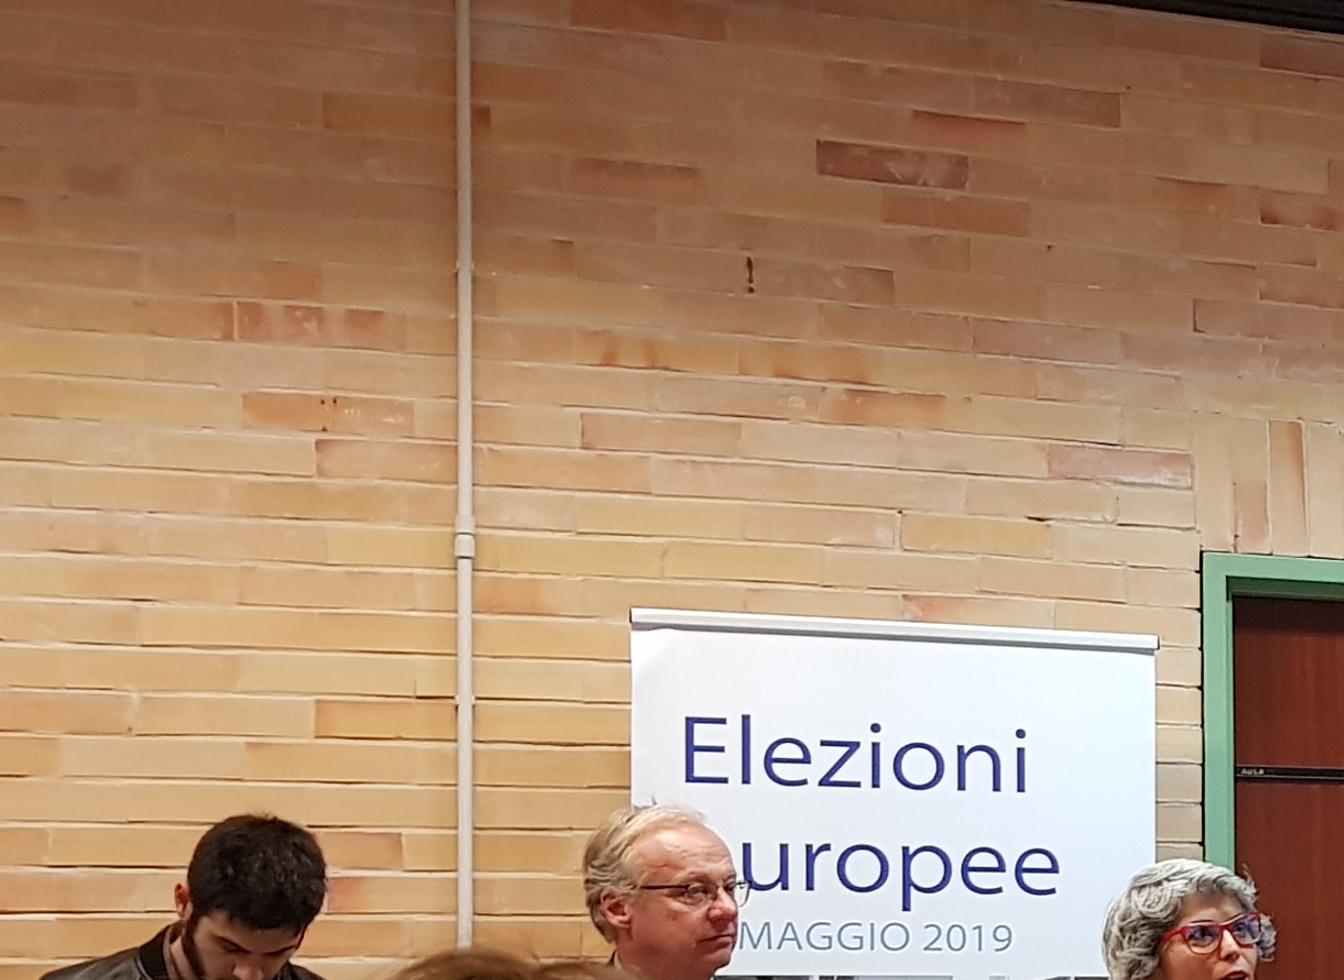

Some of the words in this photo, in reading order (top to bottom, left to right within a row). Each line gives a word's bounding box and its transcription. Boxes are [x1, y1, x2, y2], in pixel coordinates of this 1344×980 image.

[684, 713, 1027, 794] Elezioni
[741, 842, 1060, 912] uropee
[739, 921, 911, 952] MAGGIO
[922, 923, 1013, 953] 2019
